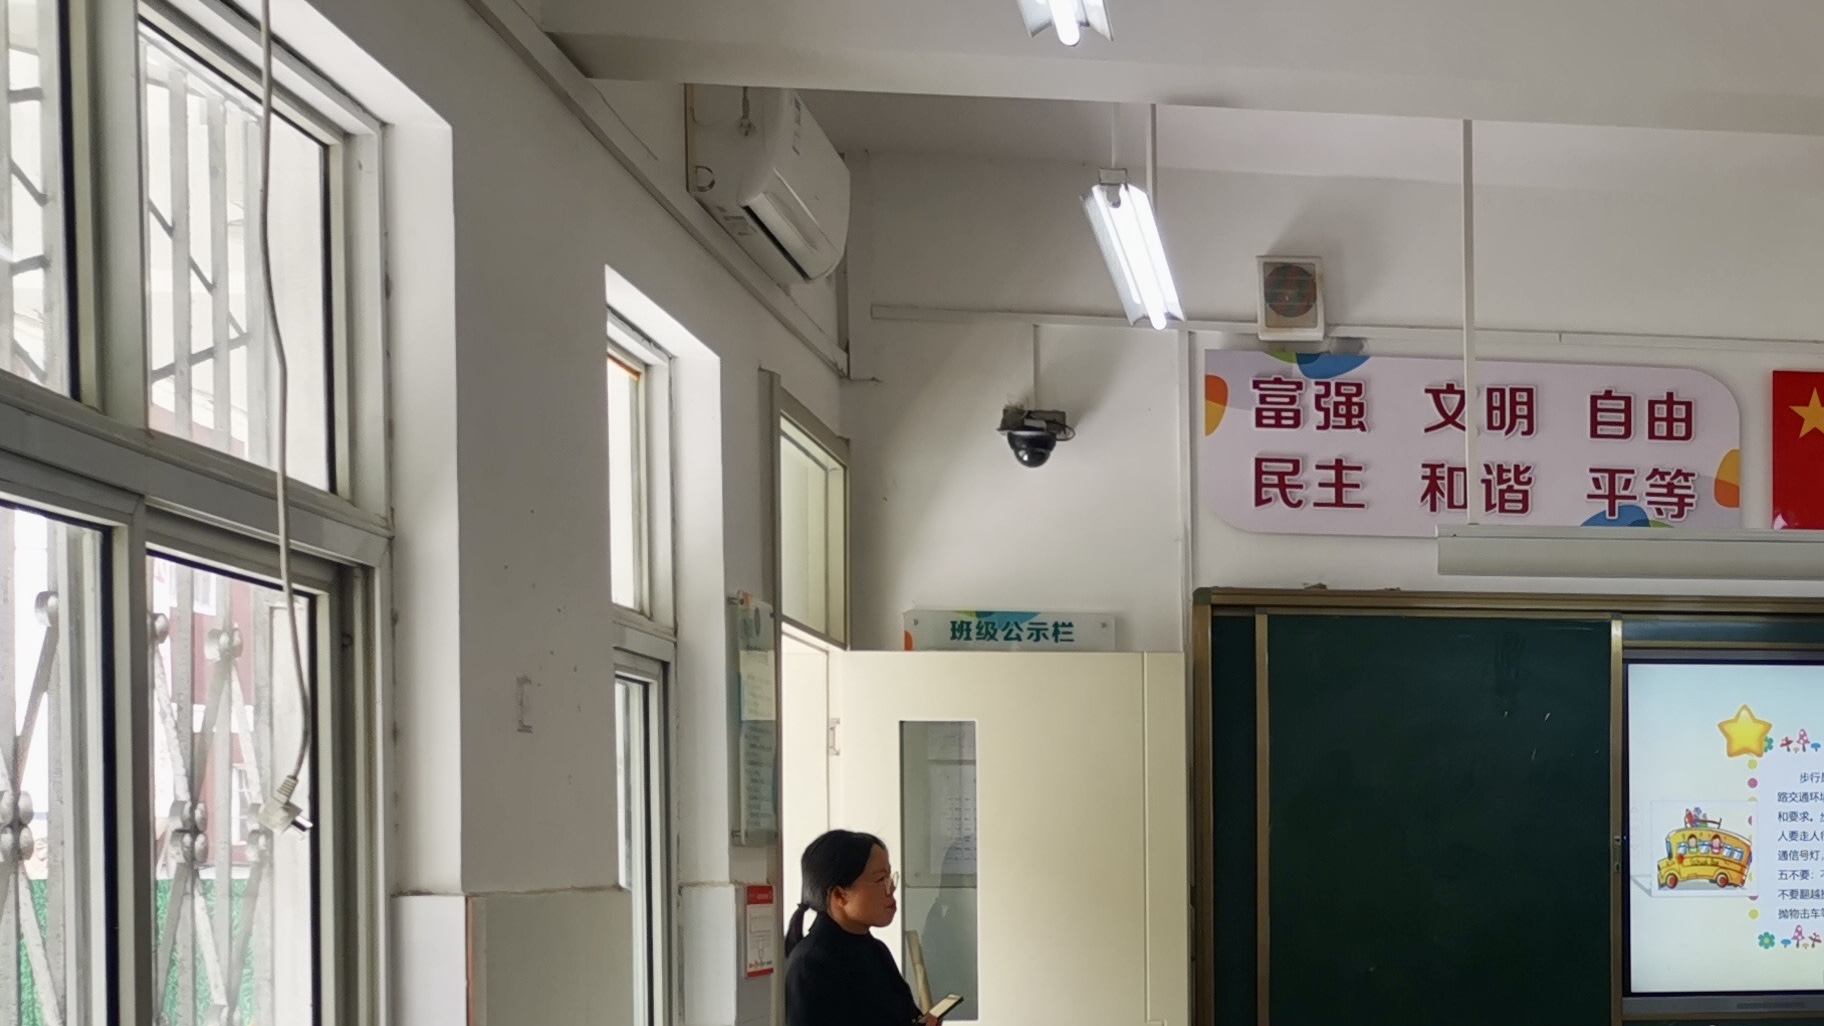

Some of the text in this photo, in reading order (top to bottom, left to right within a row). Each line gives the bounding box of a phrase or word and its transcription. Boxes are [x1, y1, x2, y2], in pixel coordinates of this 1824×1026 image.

[1251, 376, 1694, 441] 富强 文明 自由
[1254, 457, 1698, 520] 民主 和谐 平等
[950, 619, 1076, 644] 班级公示栏
